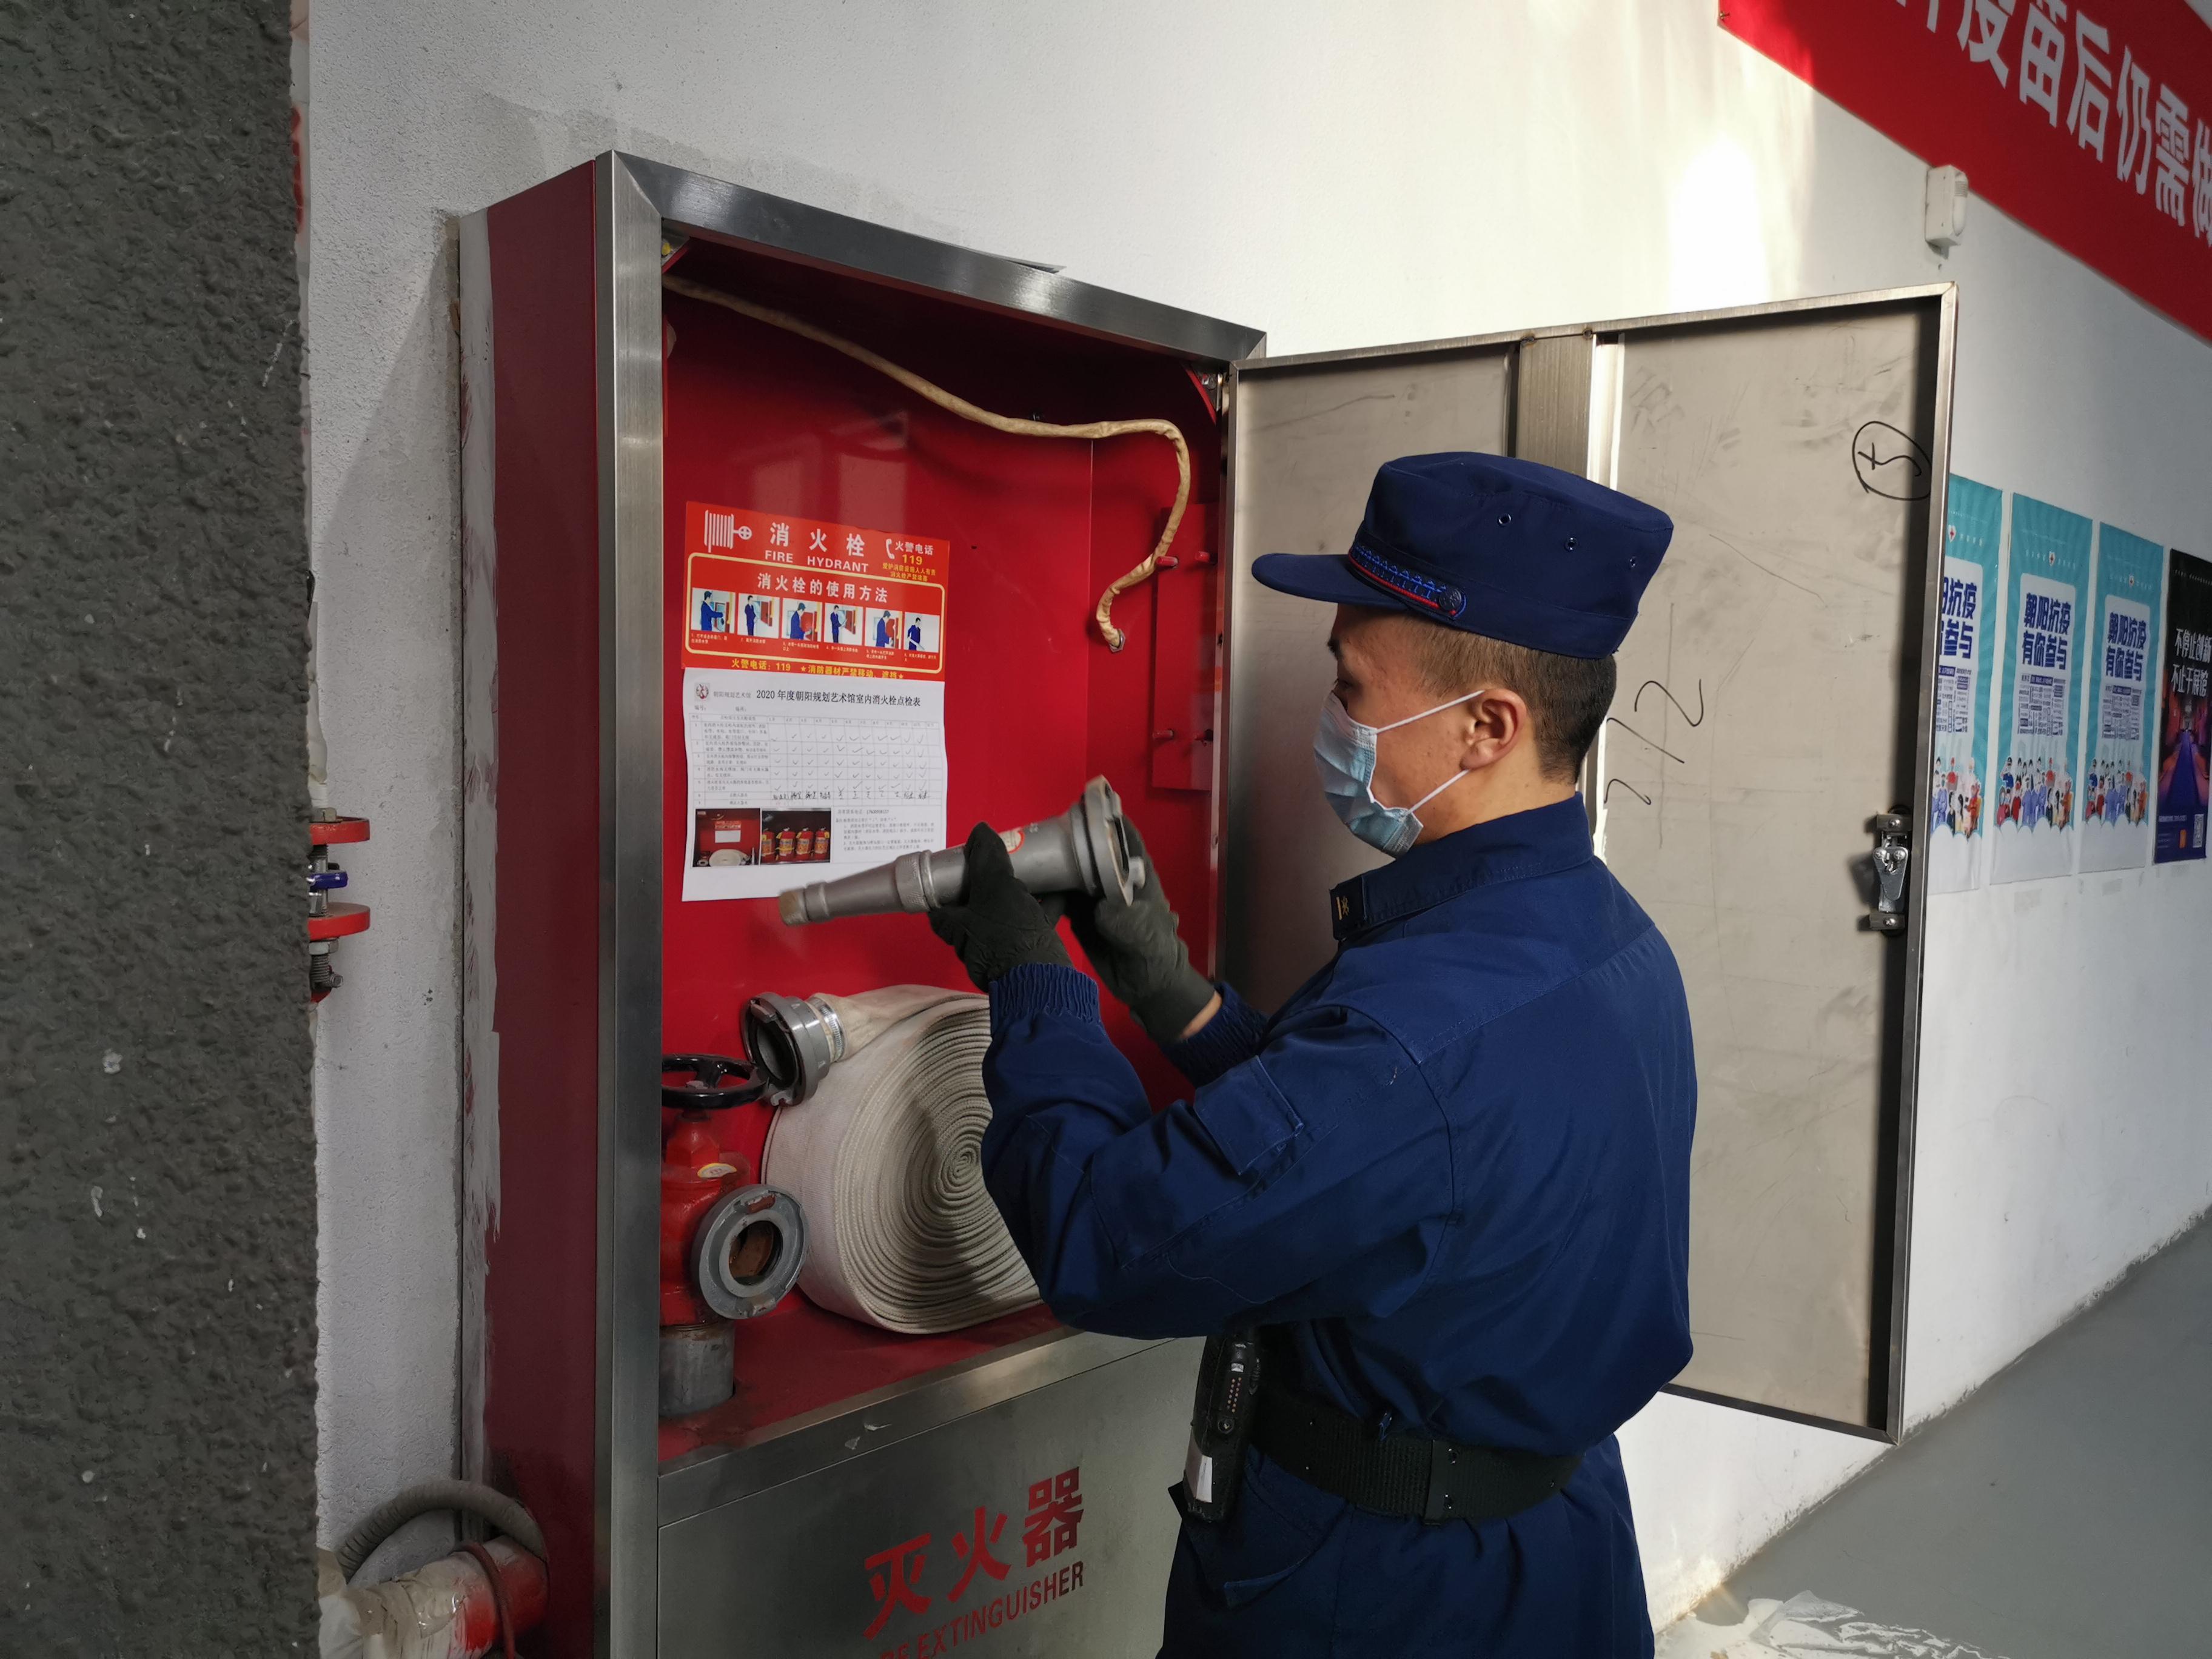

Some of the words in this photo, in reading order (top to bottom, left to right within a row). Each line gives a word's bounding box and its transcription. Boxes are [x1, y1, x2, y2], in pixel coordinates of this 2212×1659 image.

[769, 522, 865, 557] 消火栓
[895, 540, 934, 555] 火警电话
[765, 549, 794, 563] FIRE
[807, 555, 868, 573] HYDRANT
[902, 554, 923, 565] 119
[757, 572, 888, 603] 消火栓的使用方法
[2023, 592, 2071, 635] 朝阳抗疫
[2108, 611, 2147, 650] 朝阳抗疫
[1940, 618, 1974, 659] 参与
[2022, 630, 2068, 670] 有你参与
[2105, 645, 2143, 682] 有你参与
[756, 689, 775, 699] 2020
[863, 1466, 1084, 1641] 灭火器
[917, 1560, 1085, 1659] EXTINGUISHER
